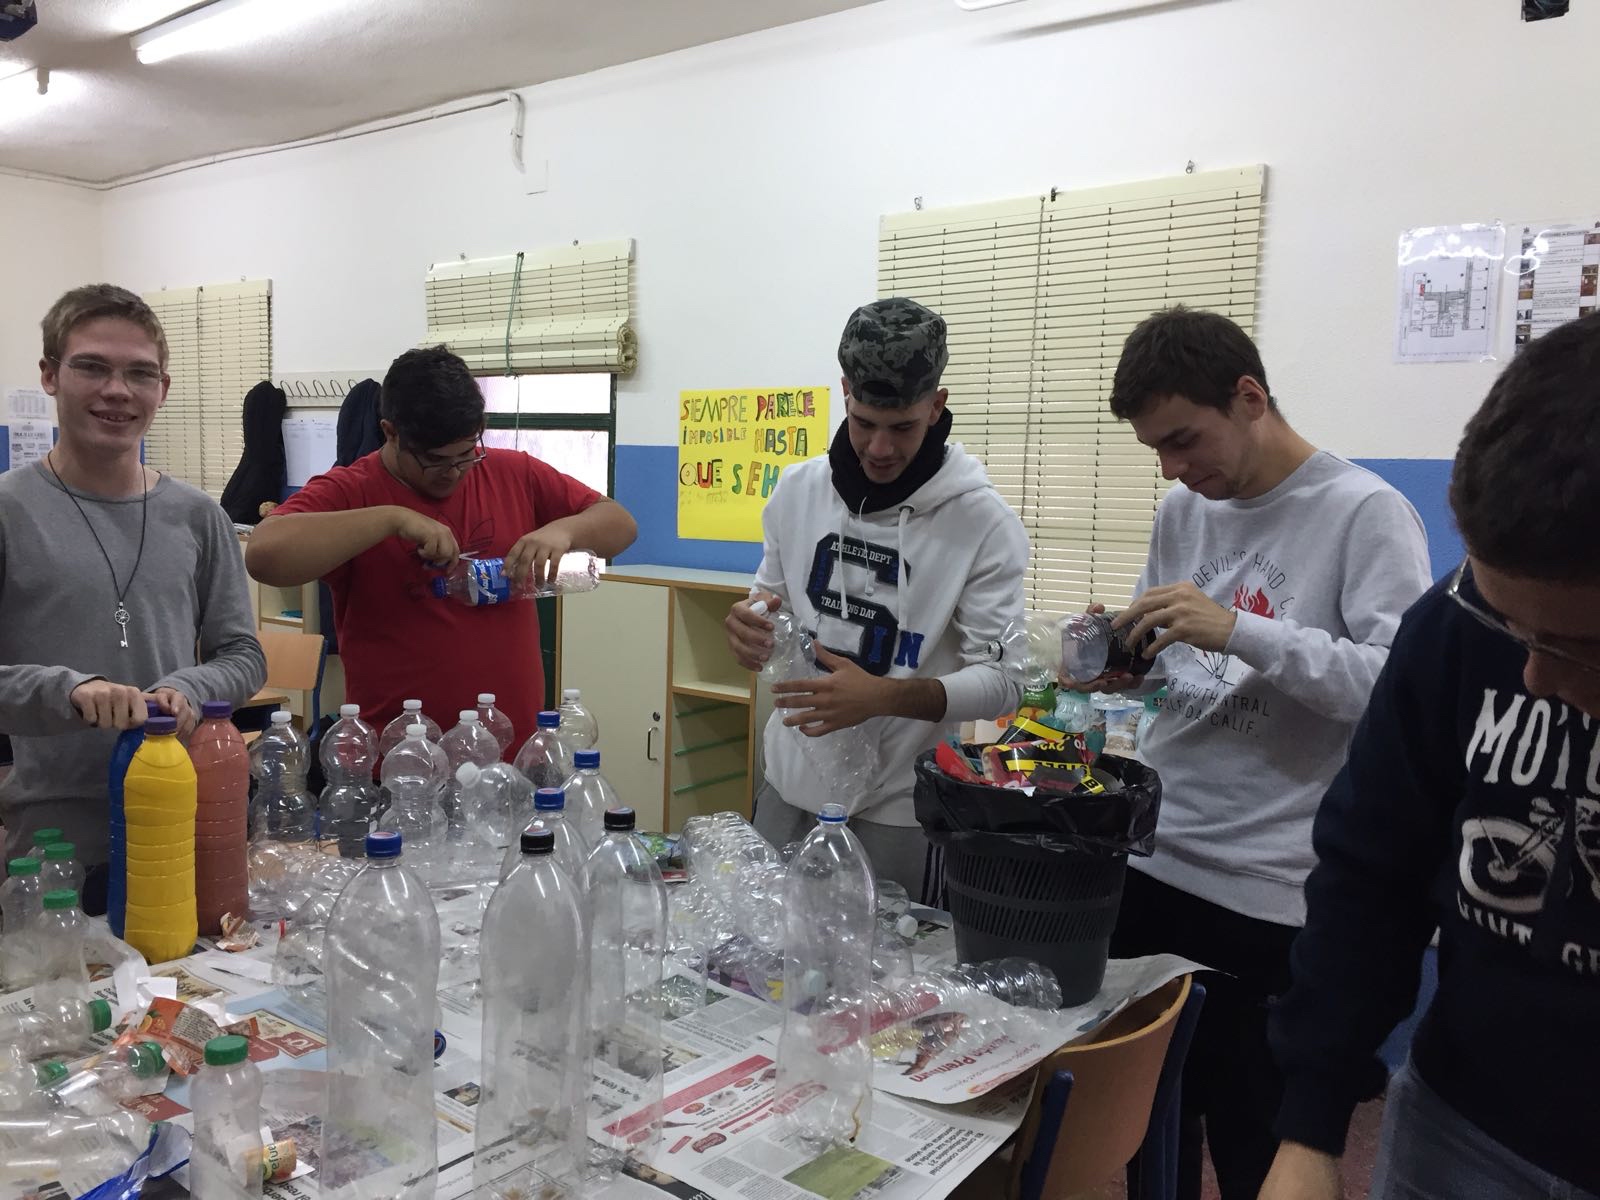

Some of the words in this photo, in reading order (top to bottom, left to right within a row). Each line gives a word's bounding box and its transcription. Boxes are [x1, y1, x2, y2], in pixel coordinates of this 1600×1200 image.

[680, 395, 748, 423] SIEMPRE
[756, 390, 815, 421] PARECE
[683, 426, 748, 445] IMPOSIBLE
[754, 426, 808, 457] HASTA
[680, 459, 723, 488] QUE
[868, 550, 893, 565] DEPT
[1252, 552, 1286, 590] HAND
[821, 595, 860, 615] TRAIING
[859, 607, 877, 620] DAY
[1179, 681, 1219, 706] SOUTH
